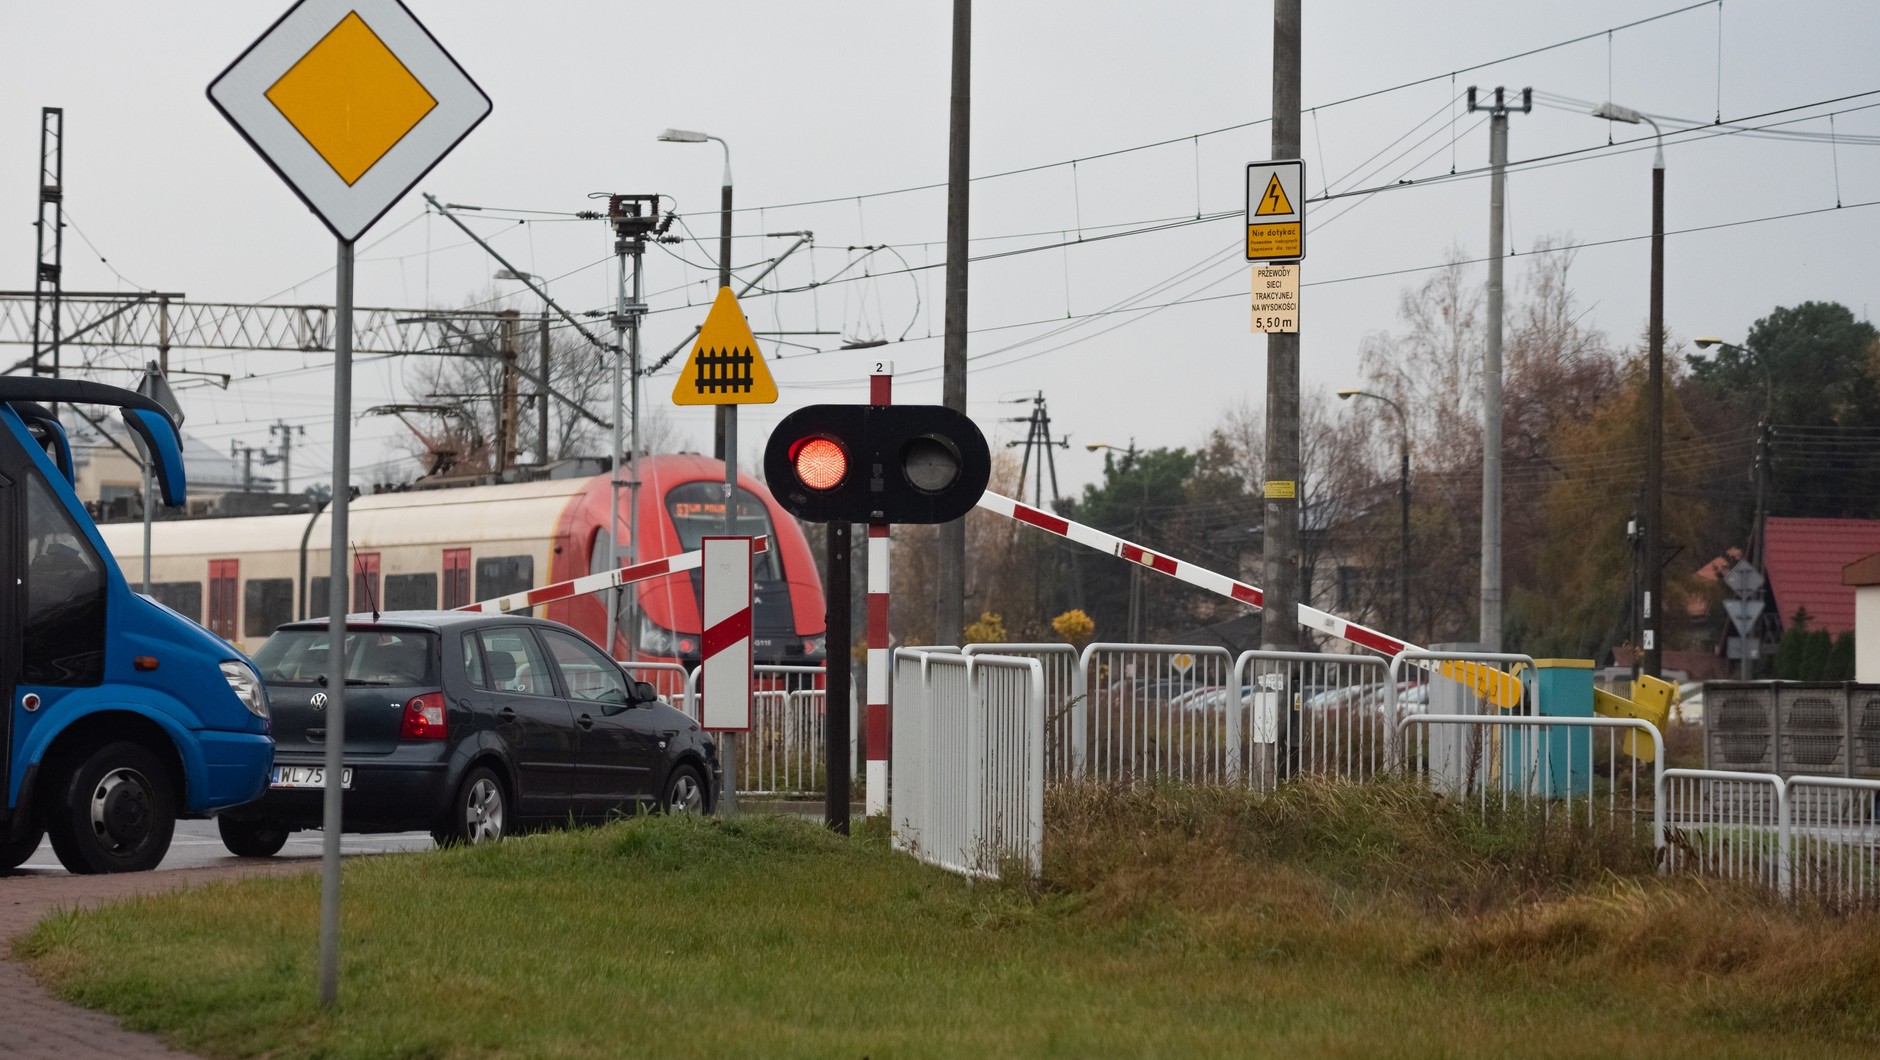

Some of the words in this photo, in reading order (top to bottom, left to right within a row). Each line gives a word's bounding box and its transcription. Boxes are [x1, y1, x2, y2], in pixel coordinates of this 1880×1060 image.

[1267, 228, 1296, 238] dotykać
[1257, 269, 1291, 277] PRZEWODY
[1266, 280, 1281, 288] SIECI
[1255, 291, 1293, 300] TRAKCYJNEJ
[1261, 302, 1297, 311] WYSOKOŚCI
[1256, 317, 1280, 329] 5,50
[1282, 319, 1292, 327] m
[876, 362, 883, 373] 2
[281, 767, 299, 783] WL
[305, 767, 351, 784] 750
